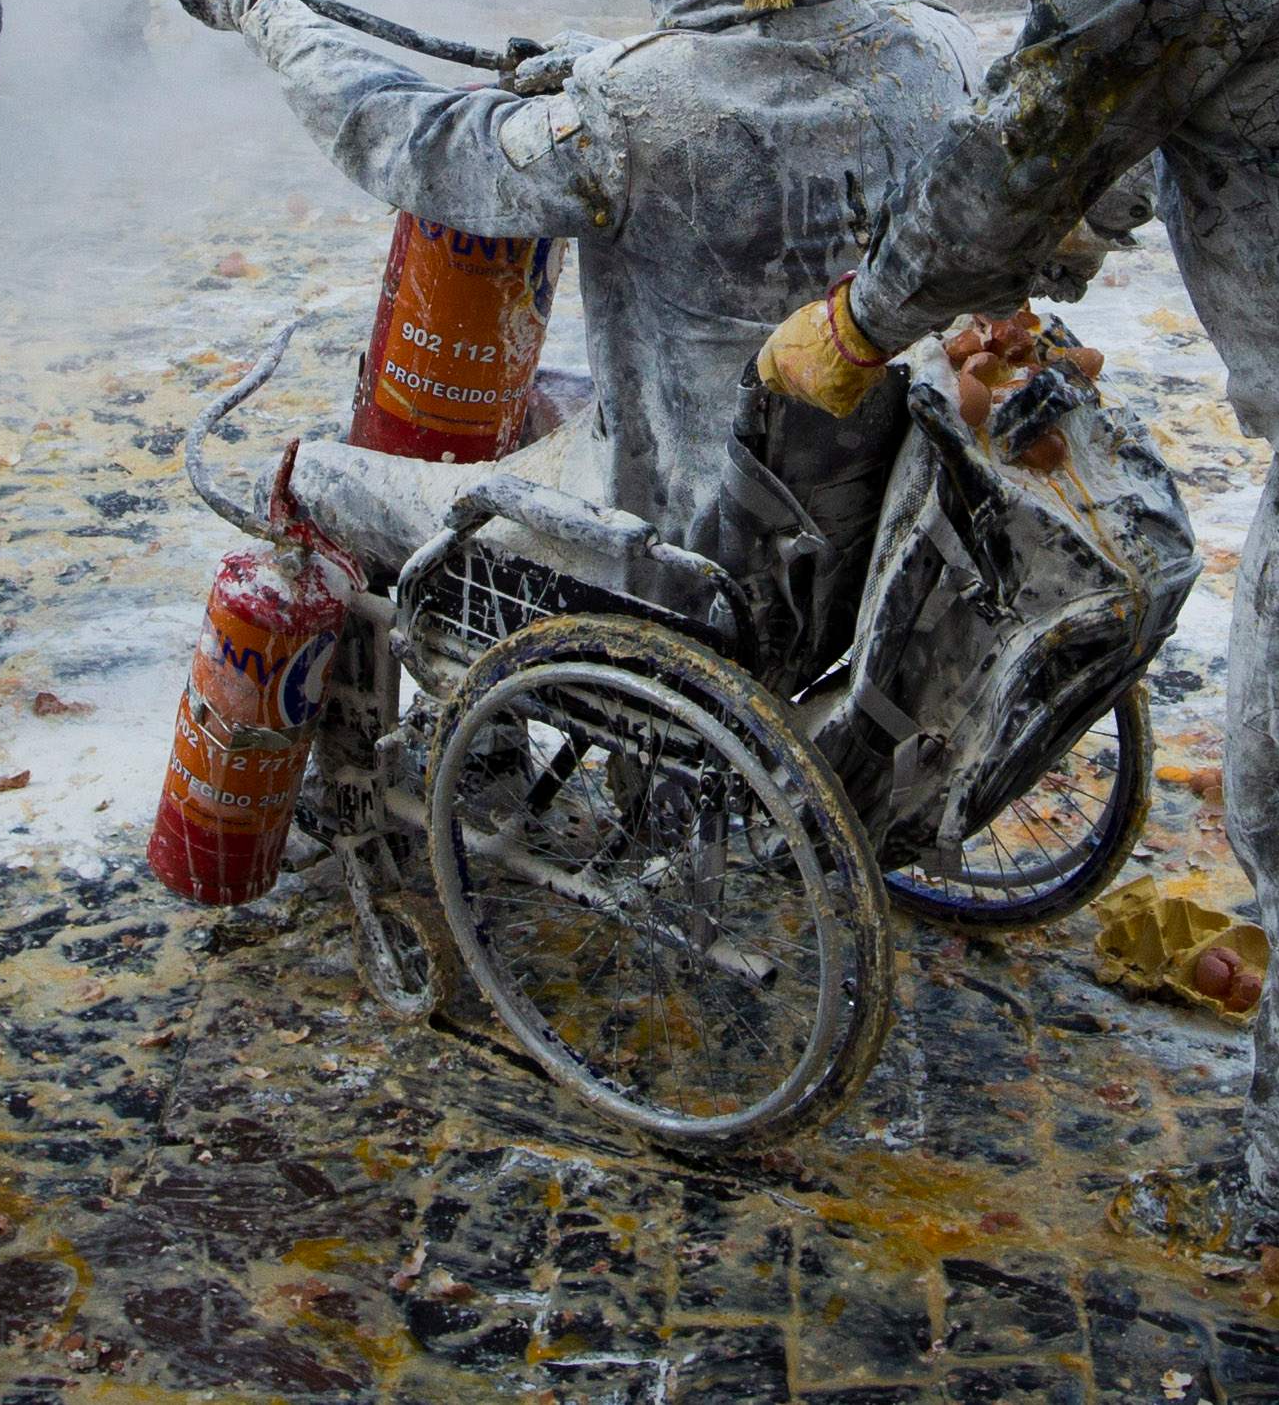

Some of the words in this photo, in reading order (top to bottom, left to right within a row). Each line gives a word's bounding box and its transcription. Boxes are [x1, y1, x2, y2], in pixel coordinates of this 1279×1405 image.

[401, 322, 443, 354] 902
[452, 341, 497, 364] 112
[385, 360, 497, 404] PROTEGIDO
